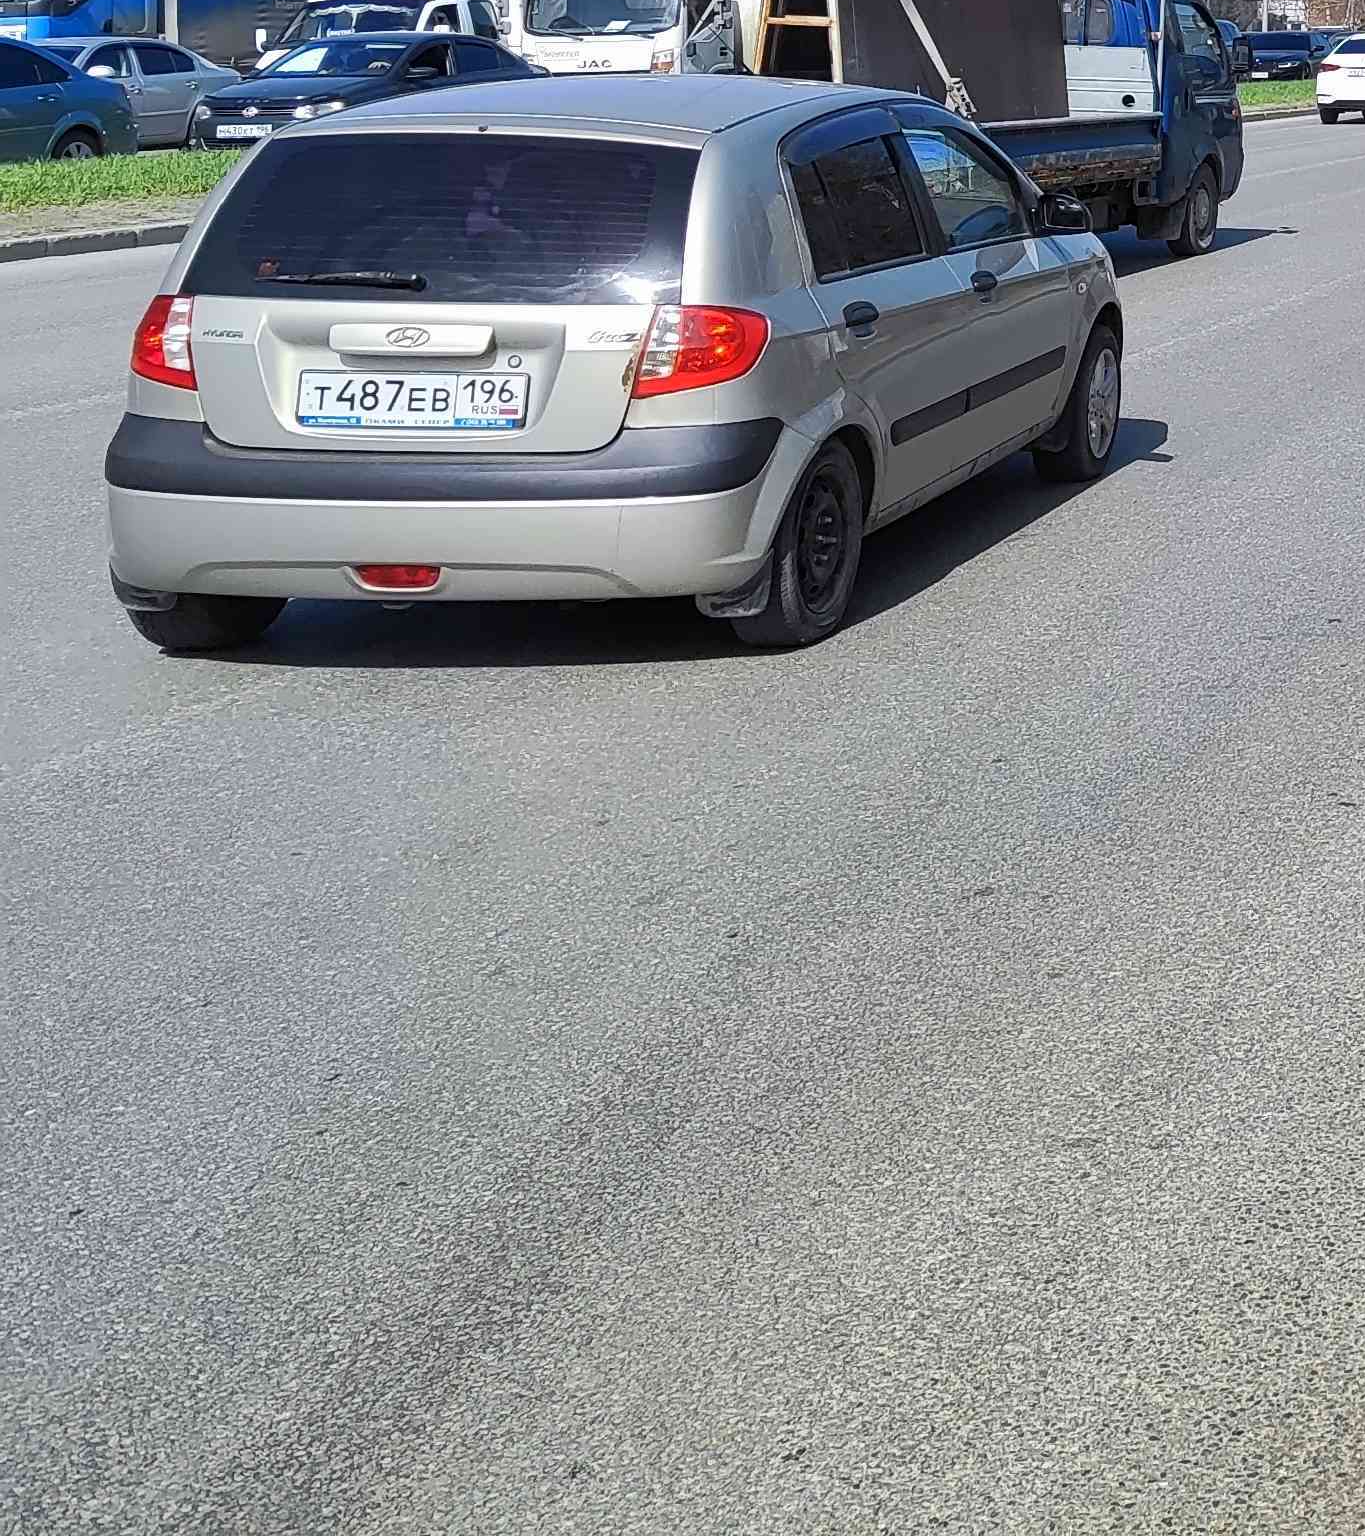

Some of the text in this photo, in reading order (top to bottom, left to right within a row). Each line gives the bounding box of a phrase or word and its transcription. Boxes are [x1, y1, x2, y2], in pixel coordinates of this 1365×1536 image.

[313, 379, 514, 413] Т487ЕВ 196
[471, 405, 498, 415] RUS
